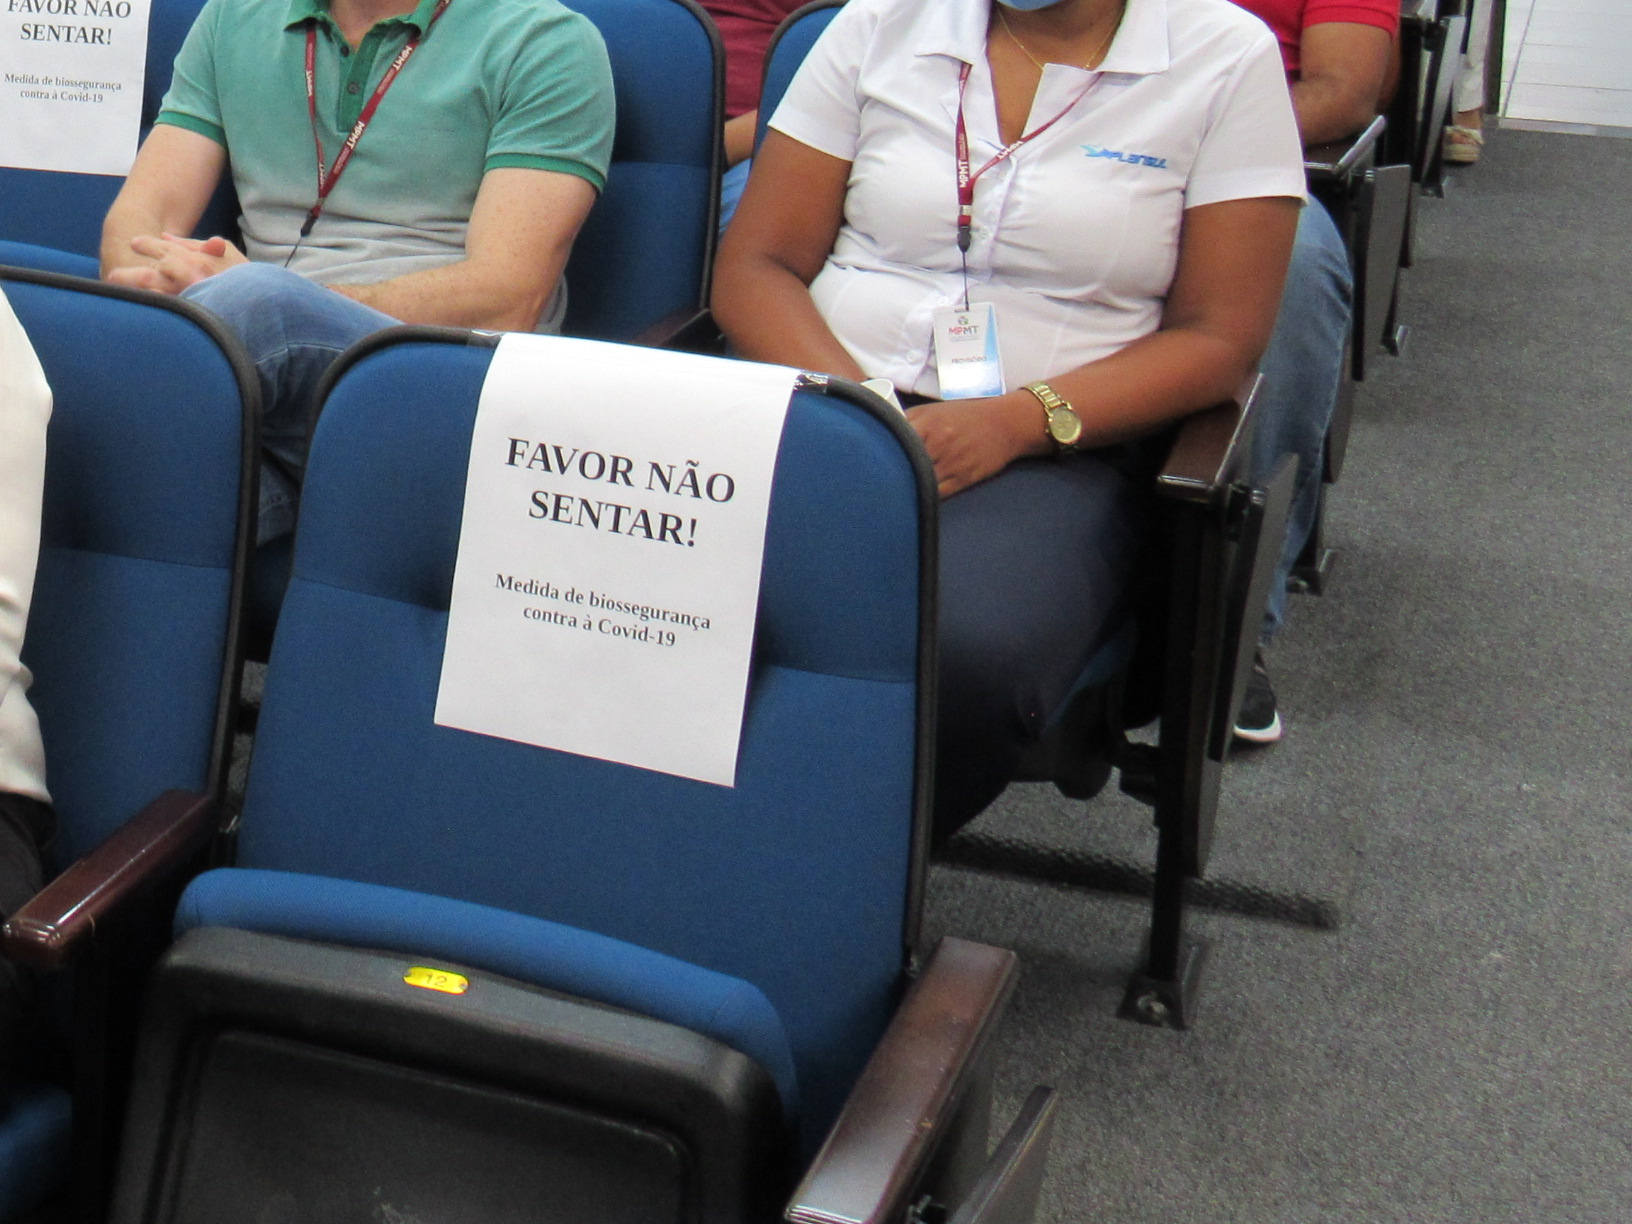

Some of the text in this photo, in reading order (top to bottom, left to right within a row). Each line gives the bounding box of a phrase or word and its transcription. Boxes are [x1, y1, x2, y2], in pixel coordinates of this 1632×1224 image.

[20, 23, 112, 45] SENTAR!
[394, 44, 413, 72] MPMT
[5, 73, 122, 91] Medida de biossegurança
[20, 90, 103, 103] contra à Covid-19
[346, 120, 366, 151] MPMT
[958, 160, 969, 189] MPMT
[948, 324, 980, 335] MPMT
[505, 436, 735, 504] FAVOR NÃO
[528, 489, 699, 548] SENTAR!
[495, 572, 711, 631] Medida de biossegurança
[523, 606, 676, 648] contra à Covid-19
